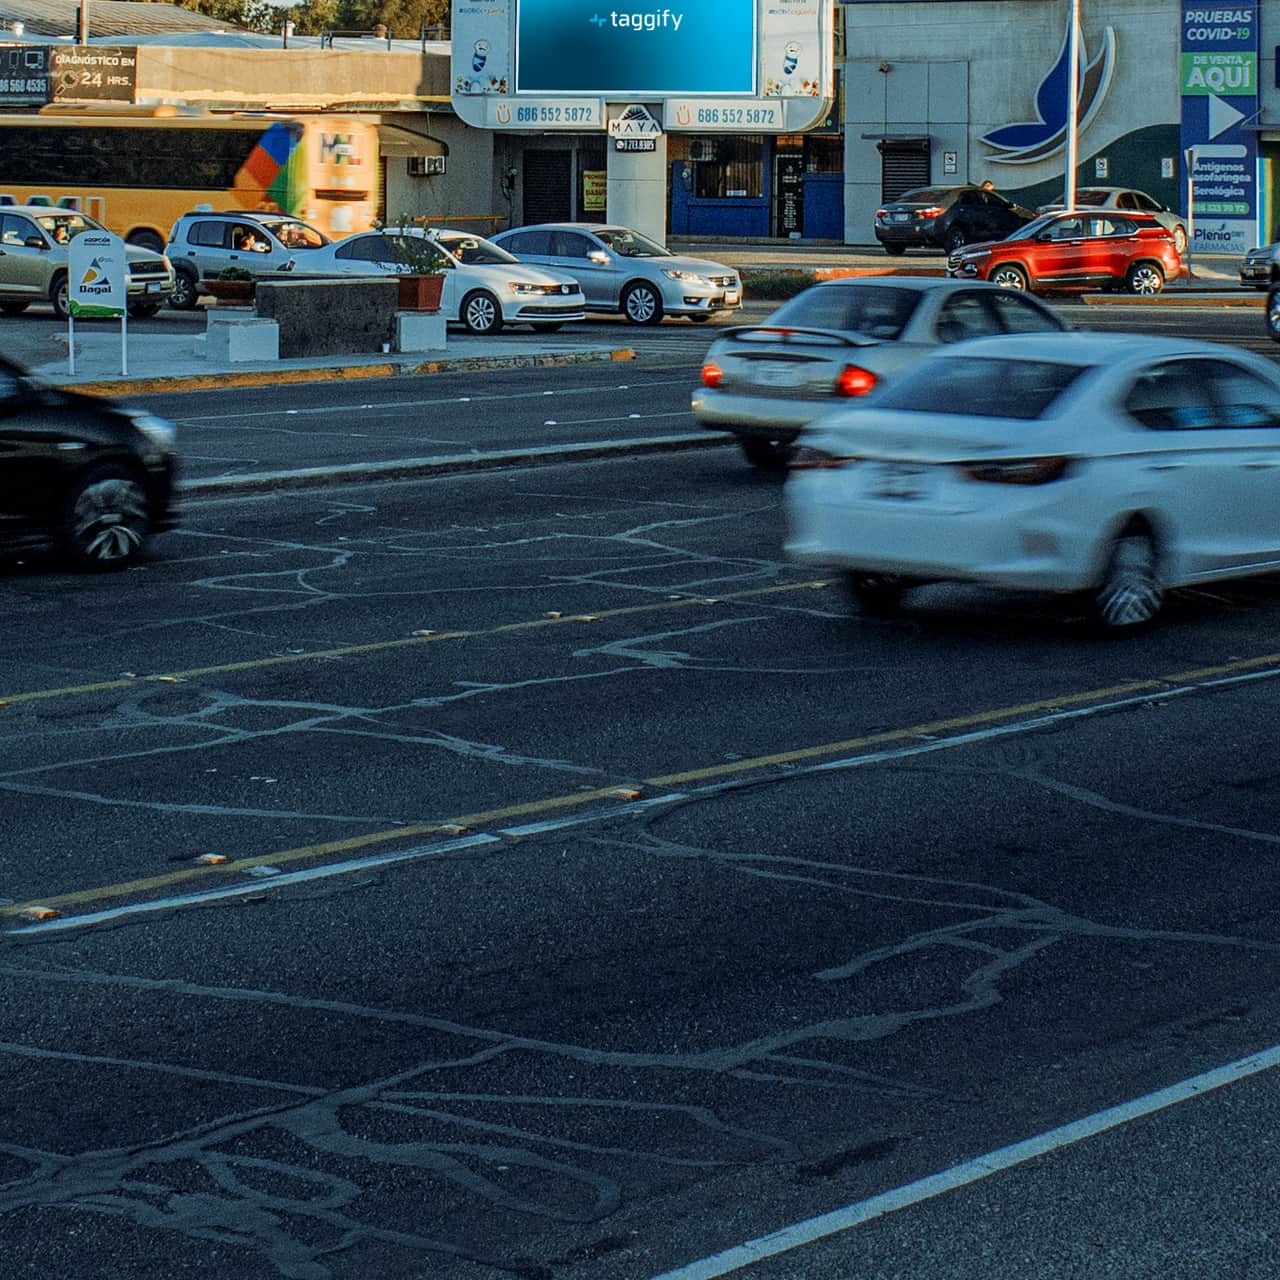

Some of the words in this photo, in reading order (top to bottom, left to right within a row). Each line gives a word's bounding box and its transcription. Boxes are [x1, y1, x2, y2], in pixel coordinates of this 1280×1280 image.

[610, 9, 683, 31] taggify
[1185, 10, 1252, 24] PRUEBAS
[1187, 27, 1250, 40] COVID-19
[121, 57, 135, 66] EN
[1193, 56, 1208, 64] DE
[1209, 55, 1243, 65] VENTA
[81, 72, 102, 87] 24
[107, 76, 132, 86] HRS.
[1186, 61, 1251, 92] AQUÍ
[517, 107, 537, 121] 686
[542, 107, 561, 121] 552
[565, 107, 592, 121] 5872
[698, 108, 718, 123] 686
[722, 109, 742, 123] 552
[746, 109, 774, 124] 5872
[612, 122, 658, 132] MAYA
[1194, 185, 1245, 197] Serológica
[1194, 228, 1231, 240] Plenia
